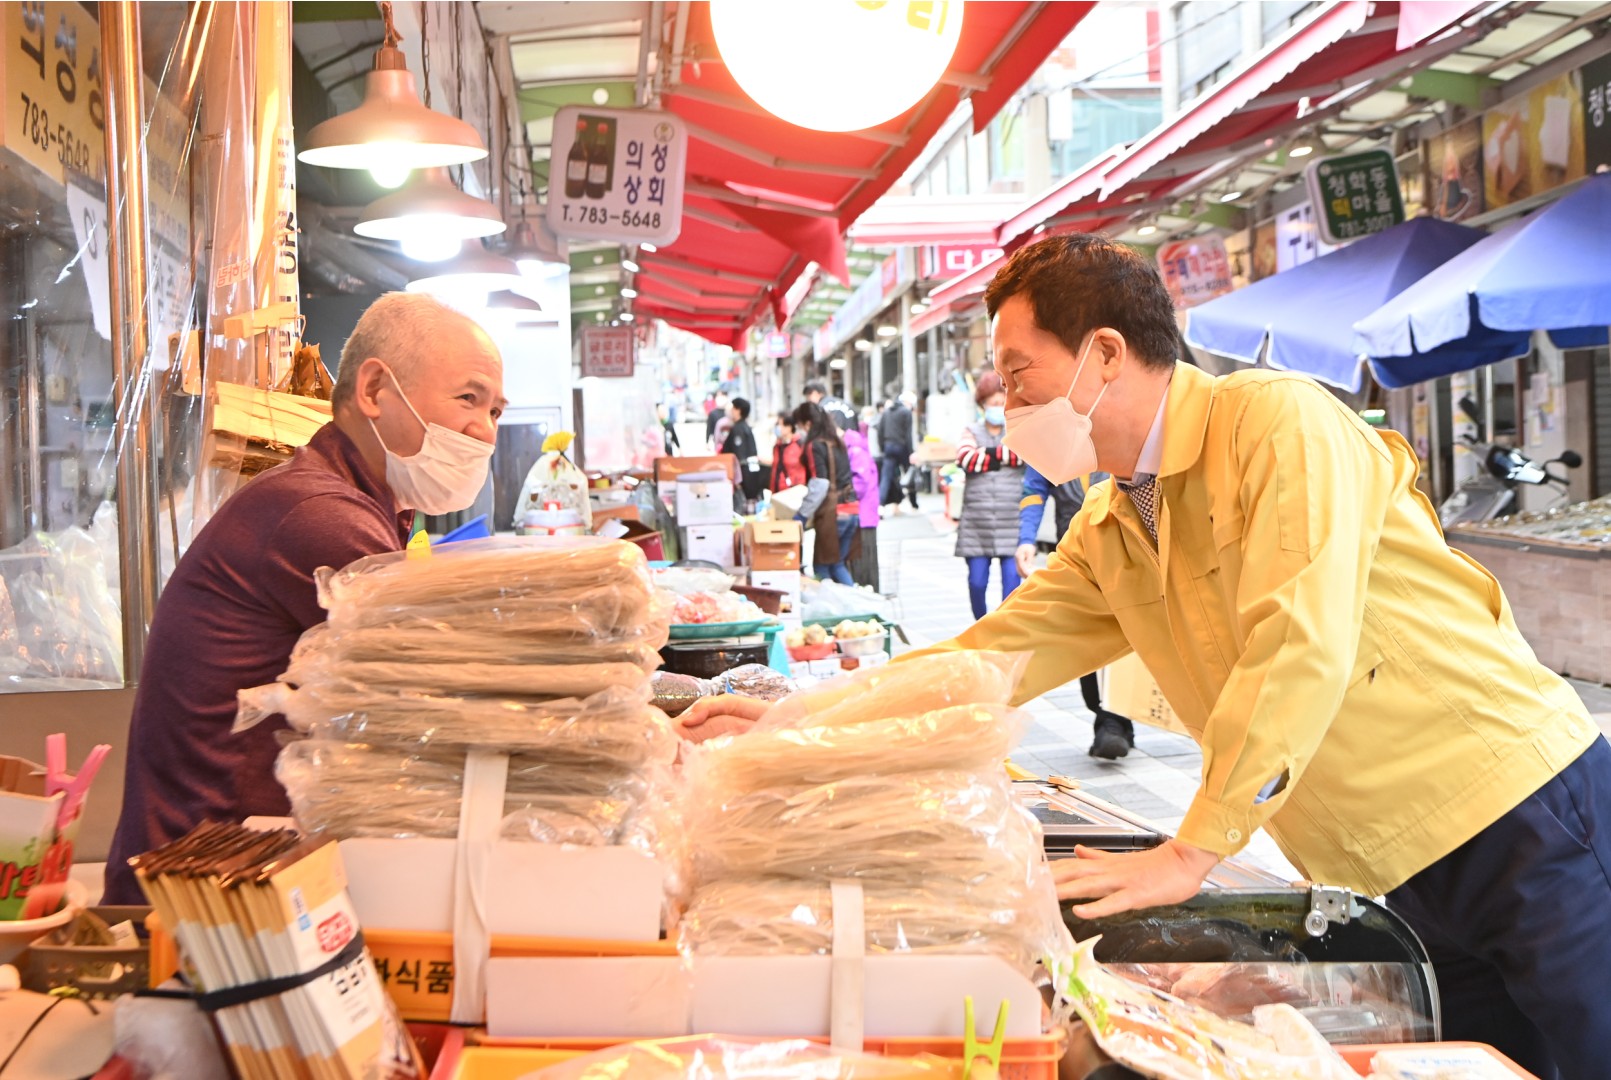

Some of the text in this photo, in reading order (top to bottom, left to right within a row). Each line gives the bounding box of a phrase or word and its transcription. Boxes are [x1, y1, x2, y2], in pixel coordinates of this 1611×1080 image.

[20, 91, 90, 178] 783-5648
[625, 140, 668, 173] 의성
[623, 175, 666, 207] 상회
[579, 206, 661, 229] 783-5648
